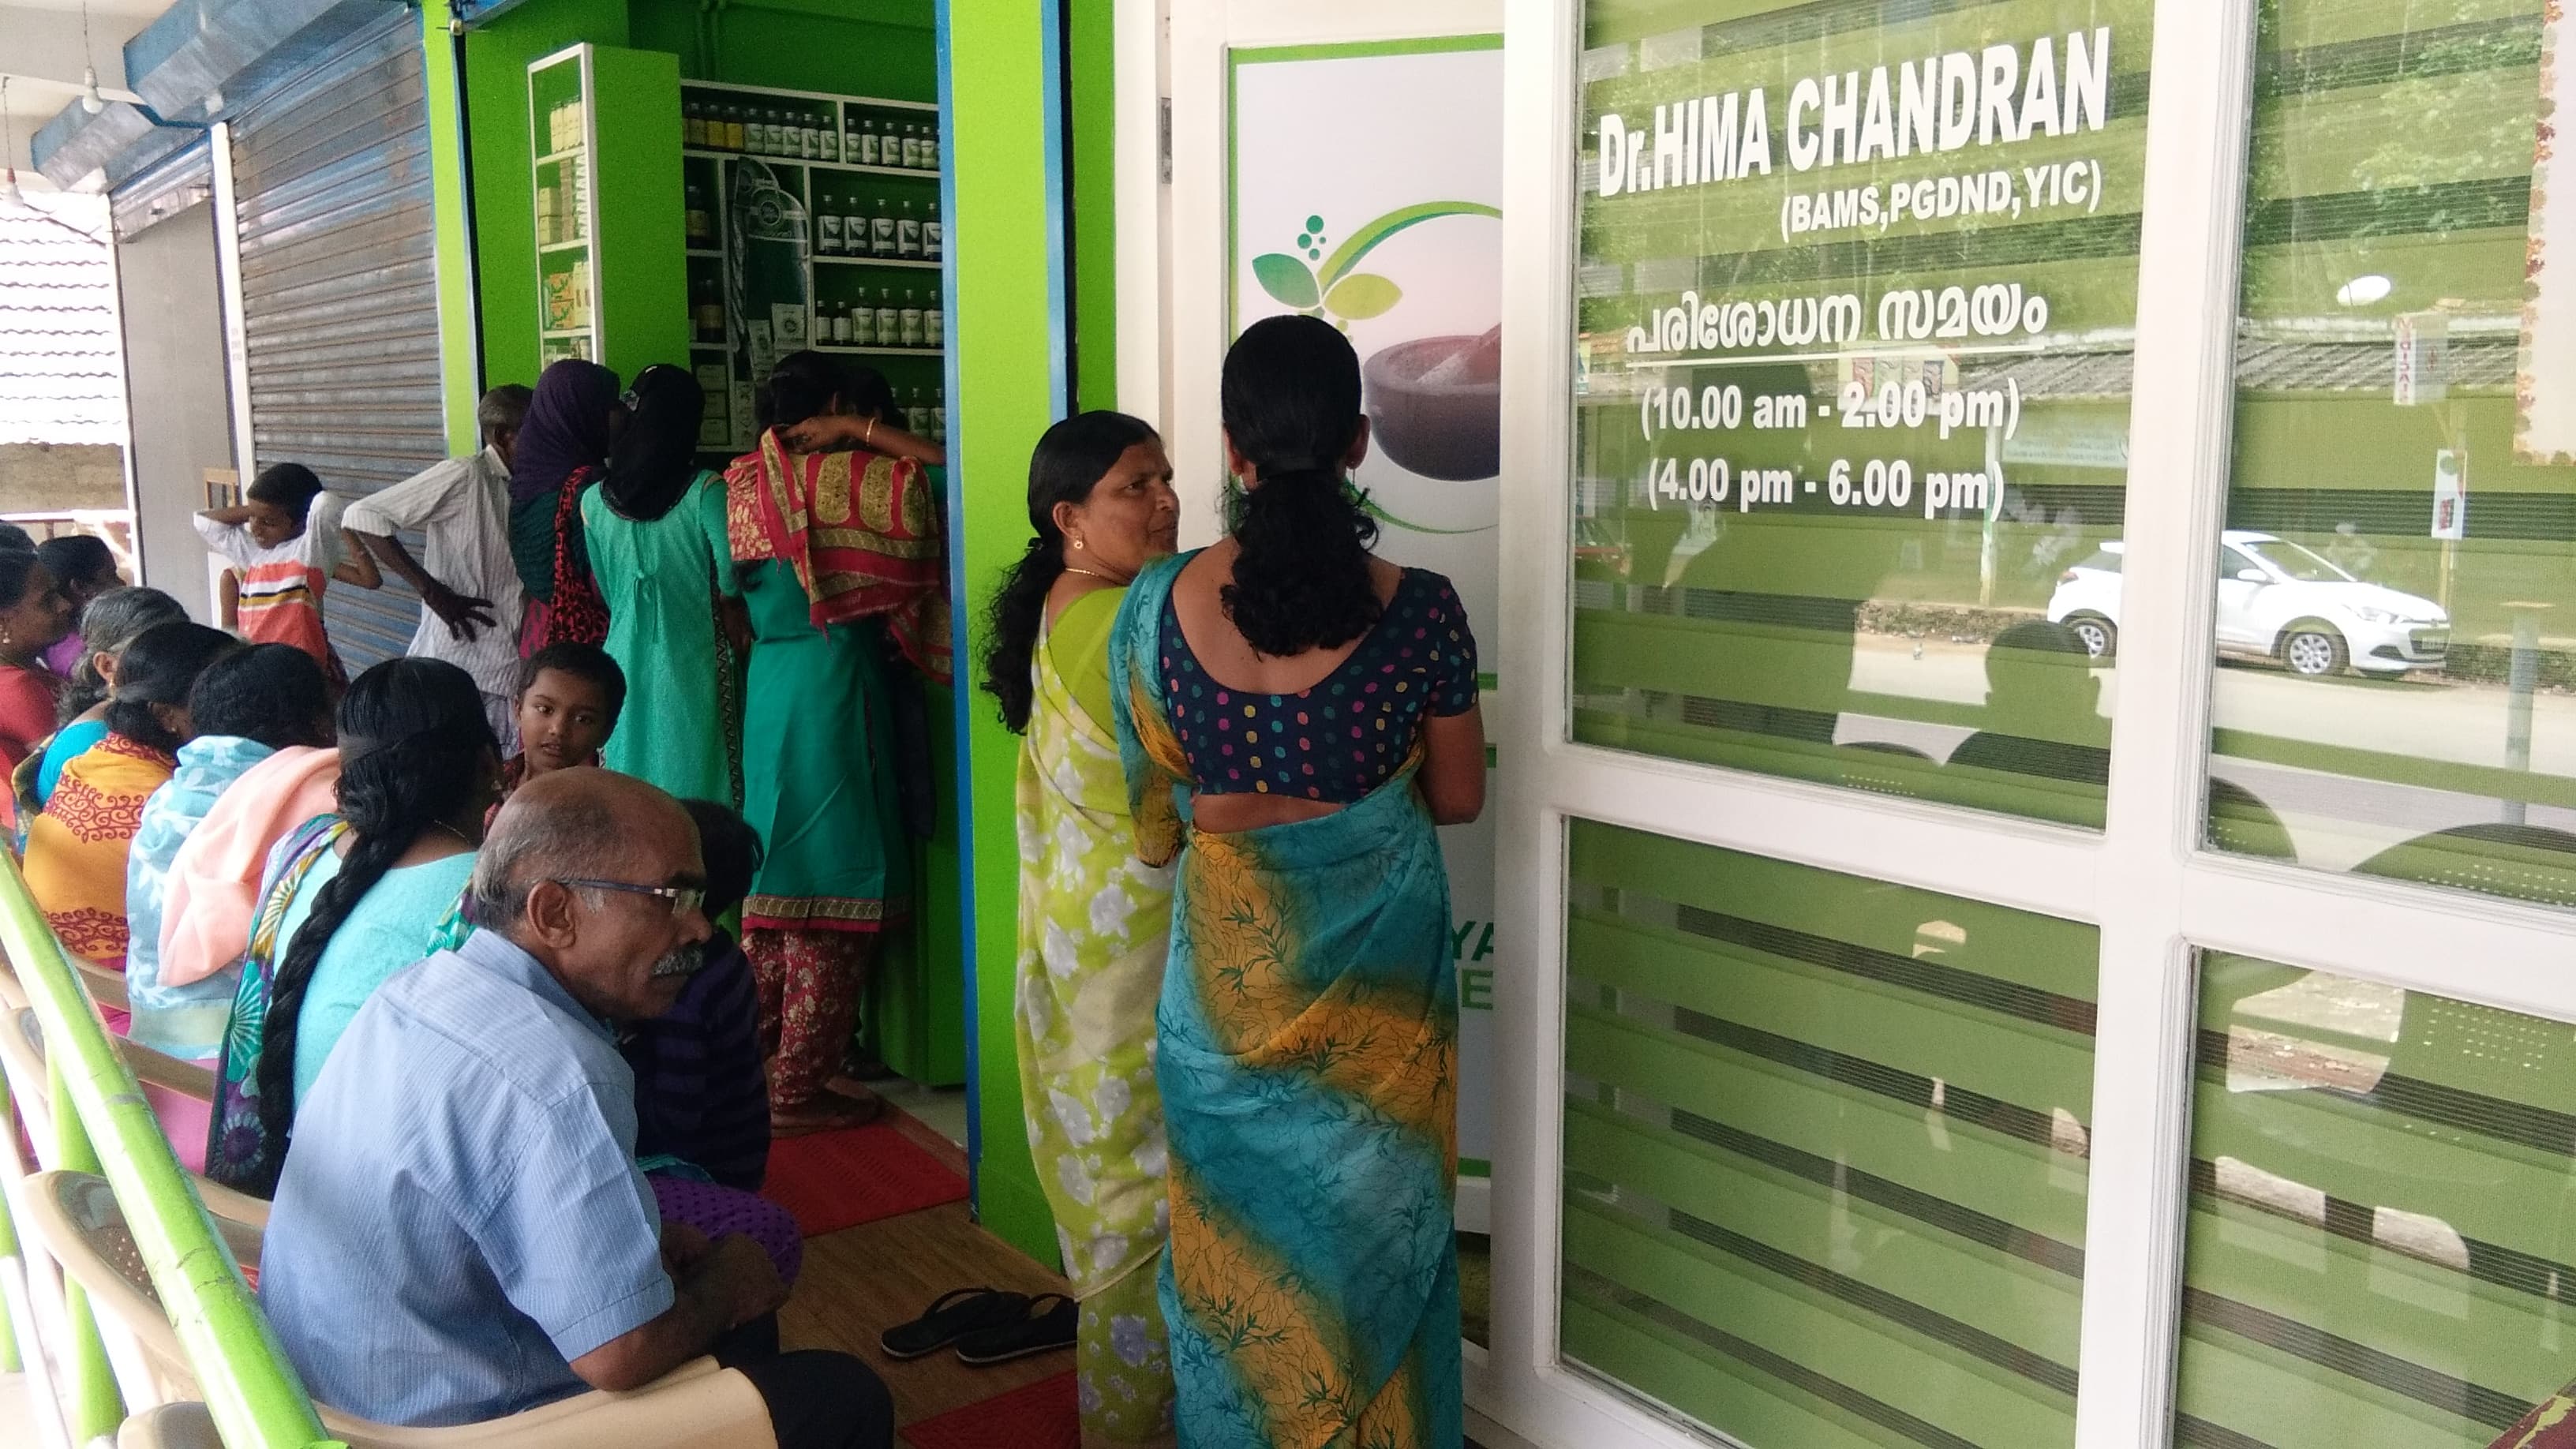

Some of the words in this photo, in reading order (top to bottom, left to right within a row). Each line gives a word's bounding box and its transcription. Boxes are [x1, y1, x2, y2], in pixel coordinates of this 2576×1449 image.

[1599, 88, 1772, 197] Dr.HIMA
[1787, 26, 2110, 171] CHANDRAN
[1780, 159, 2102, 242] (BAMS,PGDND,YIC)
[1627, 290, 1861, 353] പരിശോധന
[1878, 283, 2048, 341] സമയം
[1642, 385, 1741, 440] (10.00
[1753, 395, 1807, 428] am
[1818, 405, 1830, 417] -
[1841, 380, 1926, 429] 2.00
[1939, 377, 2020, 440] pm)
[1649, 458, 1729, 510] (4.00
[1740, 470, 1792, 512] pm
[1805, 481, 1817, 492] -
[1829, 459, 1911, 507] 6.00
[1925, 460, 2005, 522] pm)
